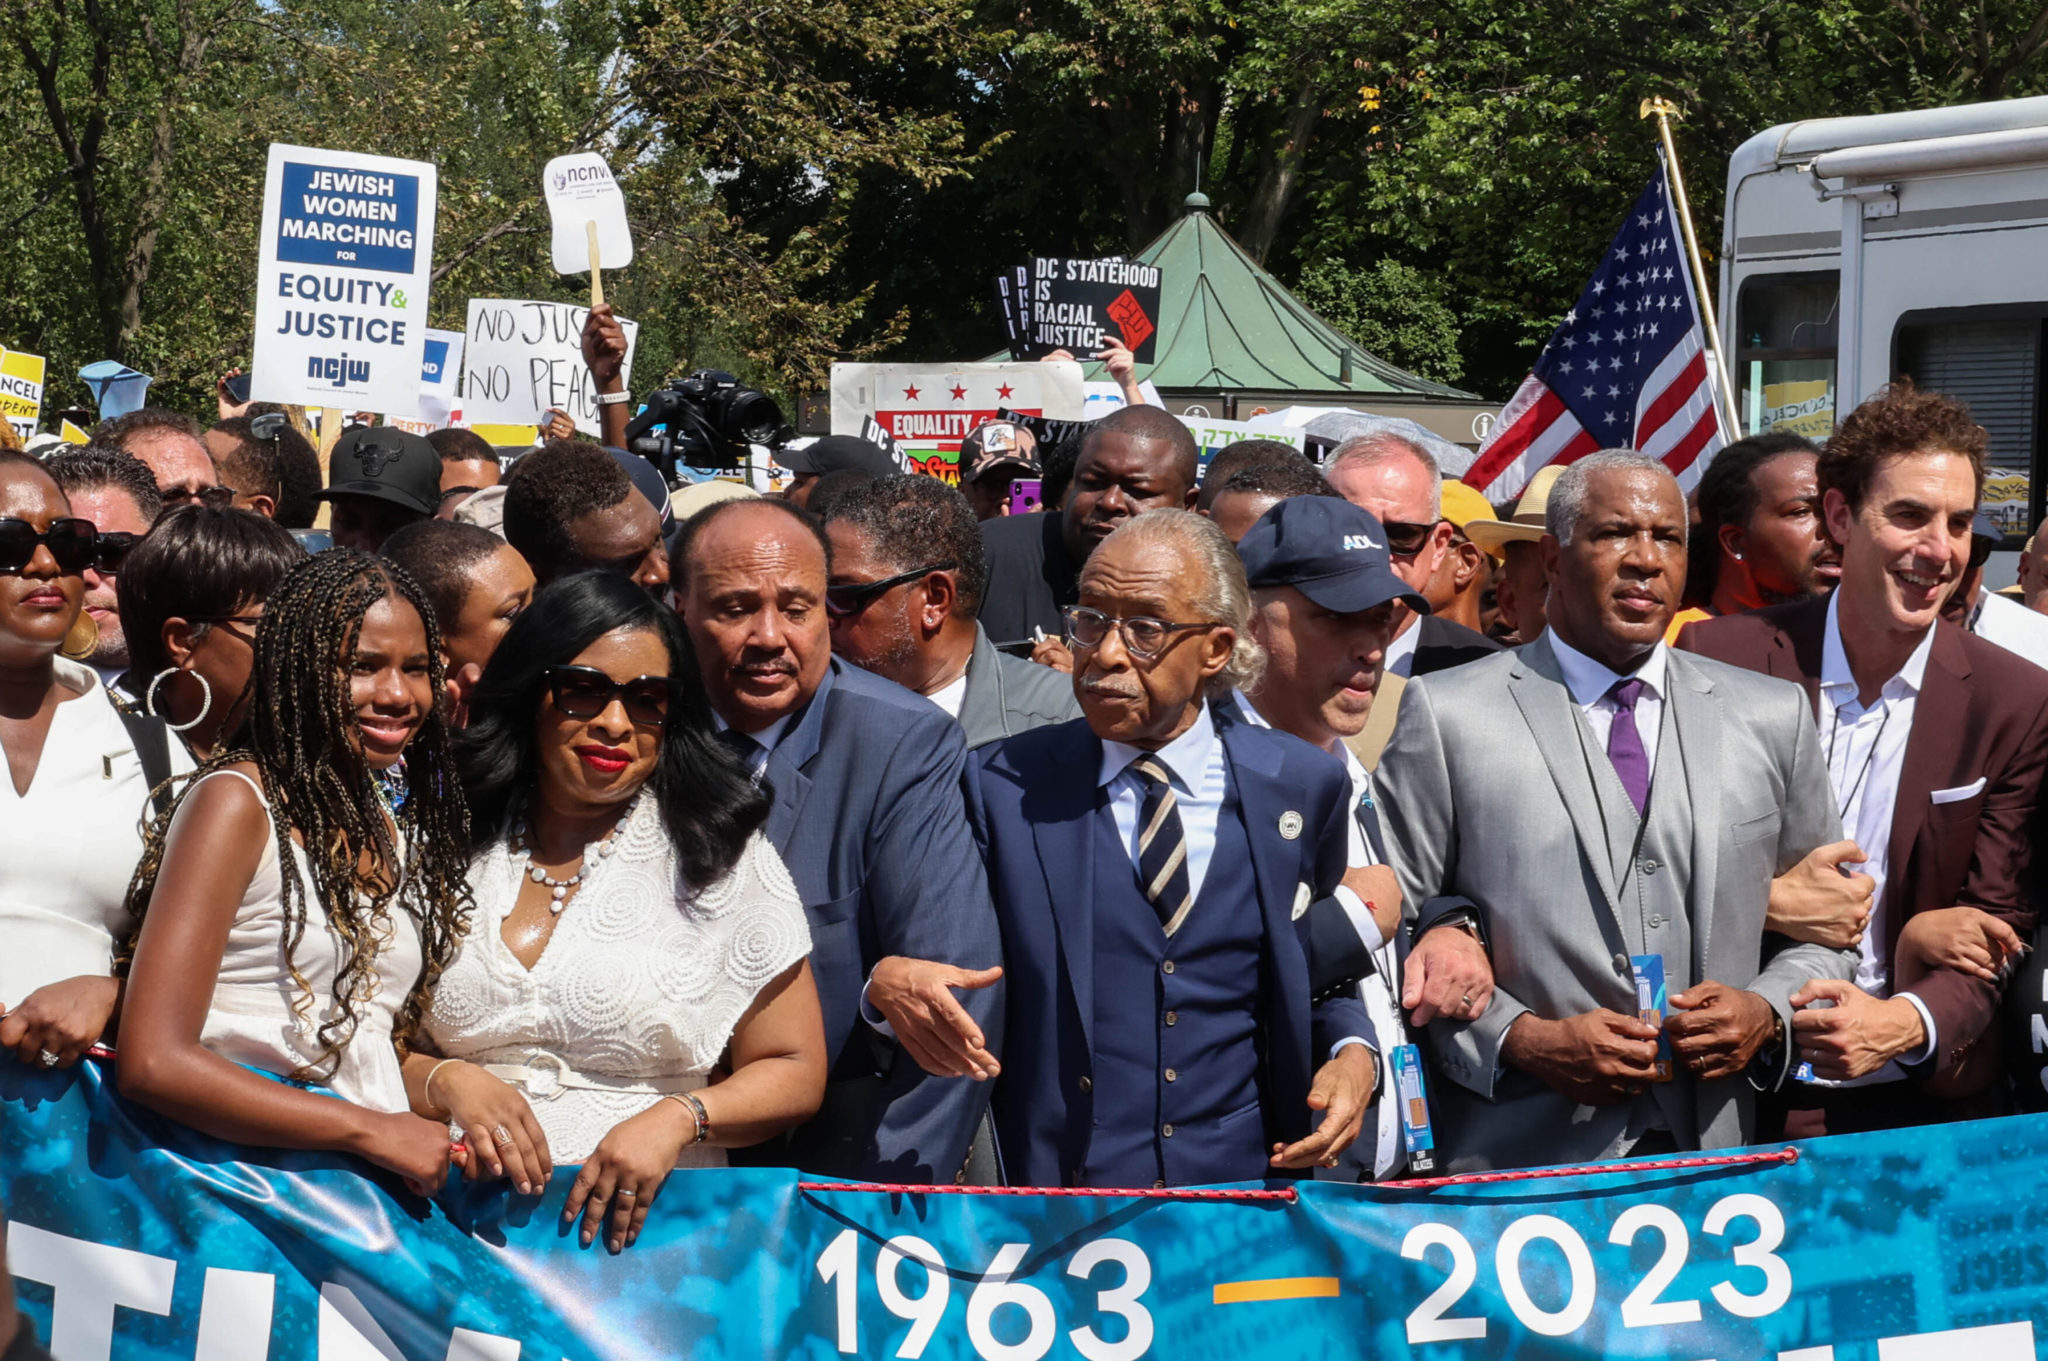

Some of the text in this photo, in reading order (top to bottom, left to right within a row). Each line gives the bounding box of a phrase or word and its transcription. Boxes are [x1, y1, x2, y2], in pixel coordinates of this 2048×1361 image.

[308, 171, 394, 197] JEWISH
[303, 194, 397, 222] WOMEN
[282, 218, 413, 249] MARCHING
[336, 250, 357, 261] FOR
[1035, 257, 1158, 288] DC STATEHOOD
[1035, 279, 1051, 301] IS
[277, 310, 406, 345] JUSTICE
[475, 307, 515, 343] NO
[1034, 302, 1097, 326] RACIAL
[1035, 323, 1106, 349] JUSTICE
[308, 352, 370, 387] ncjw
[469, 364, 510, 403] NO
[867, 419, 889, 450] DC
[893, 413, 973, 439] EQUALITY
[1343, 535, 1383, 550] ADL
[816, 1229, 1154, 1361] 1963
[1400, 1193, 1792, 1344] 2023
